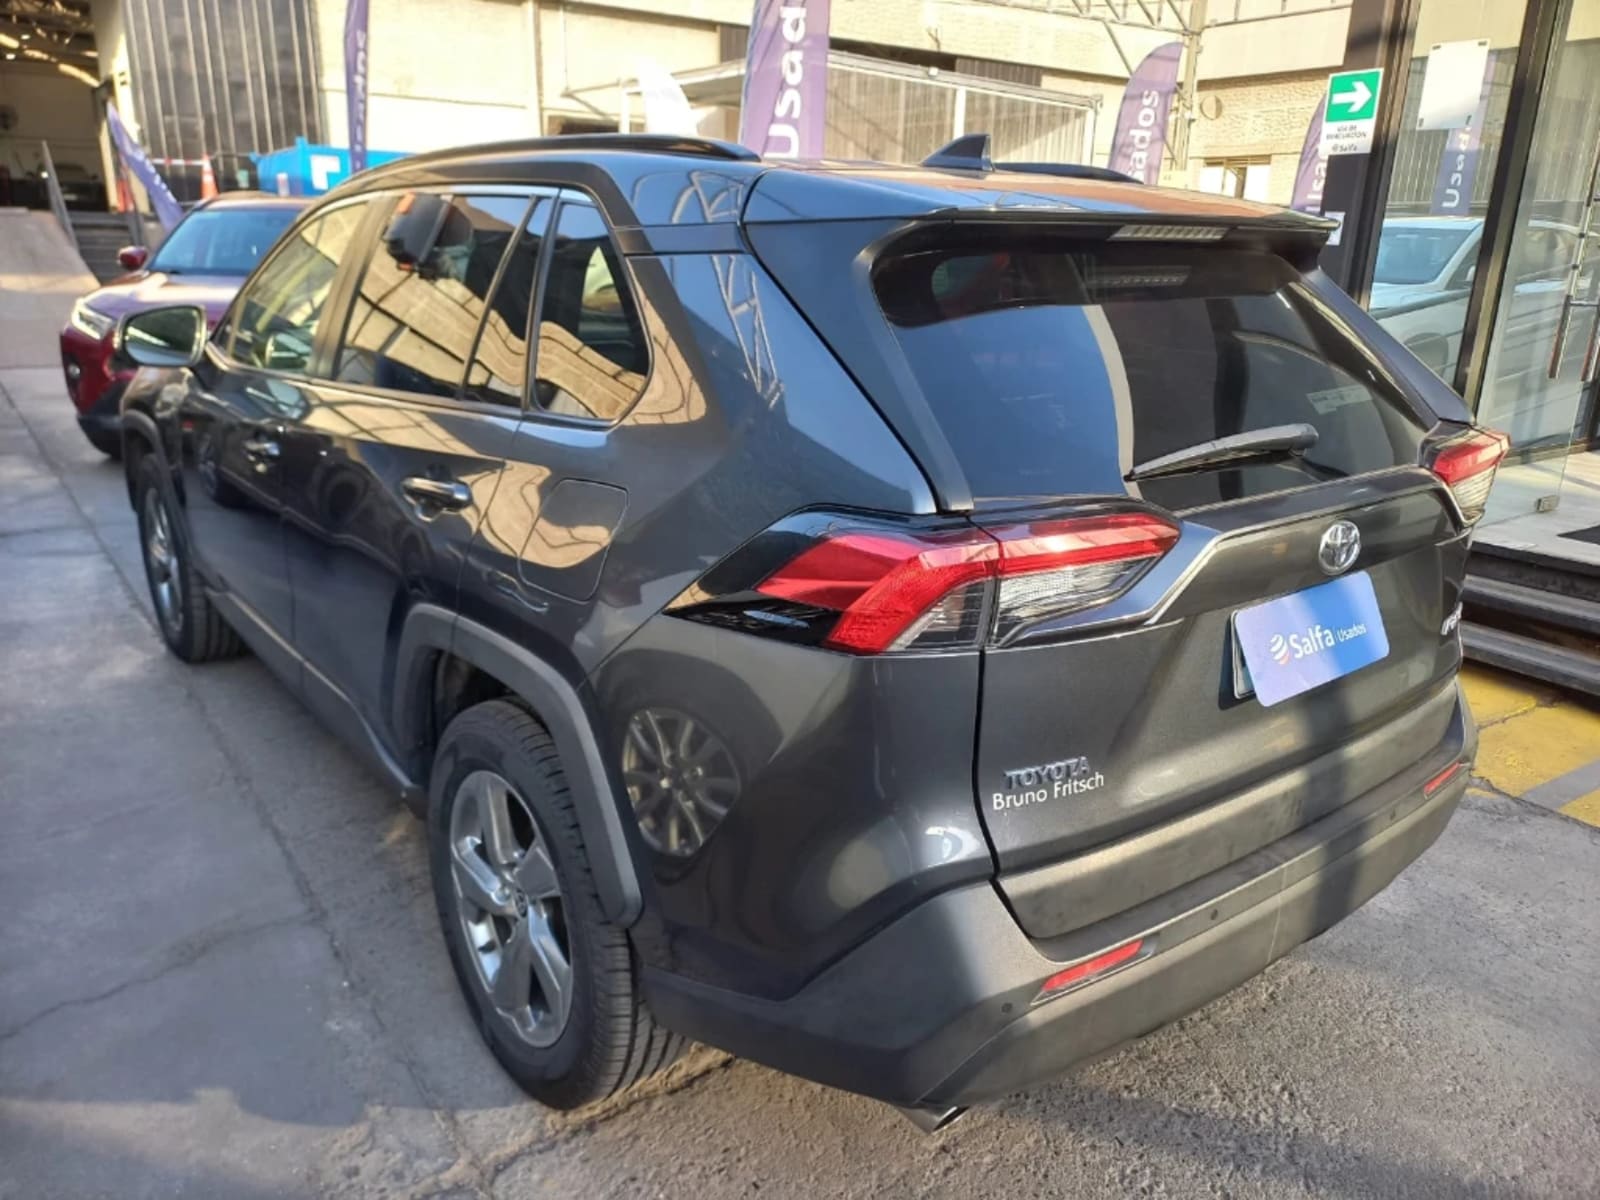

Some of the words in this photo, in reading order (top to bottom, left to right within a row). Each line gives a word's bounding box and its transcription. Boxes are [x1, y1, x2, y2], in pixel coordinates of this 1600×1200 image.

[763, 6, 807, 159] Usad
[1288, 624, 1336, 659] Salfa
[1336, 623, 1367, 642] Usados
[992, 788, 1048, 811] Bruno
[1053, 771, 1105, 799] Fritsch
[1004, 756, 1089, 790] TOYOTA
